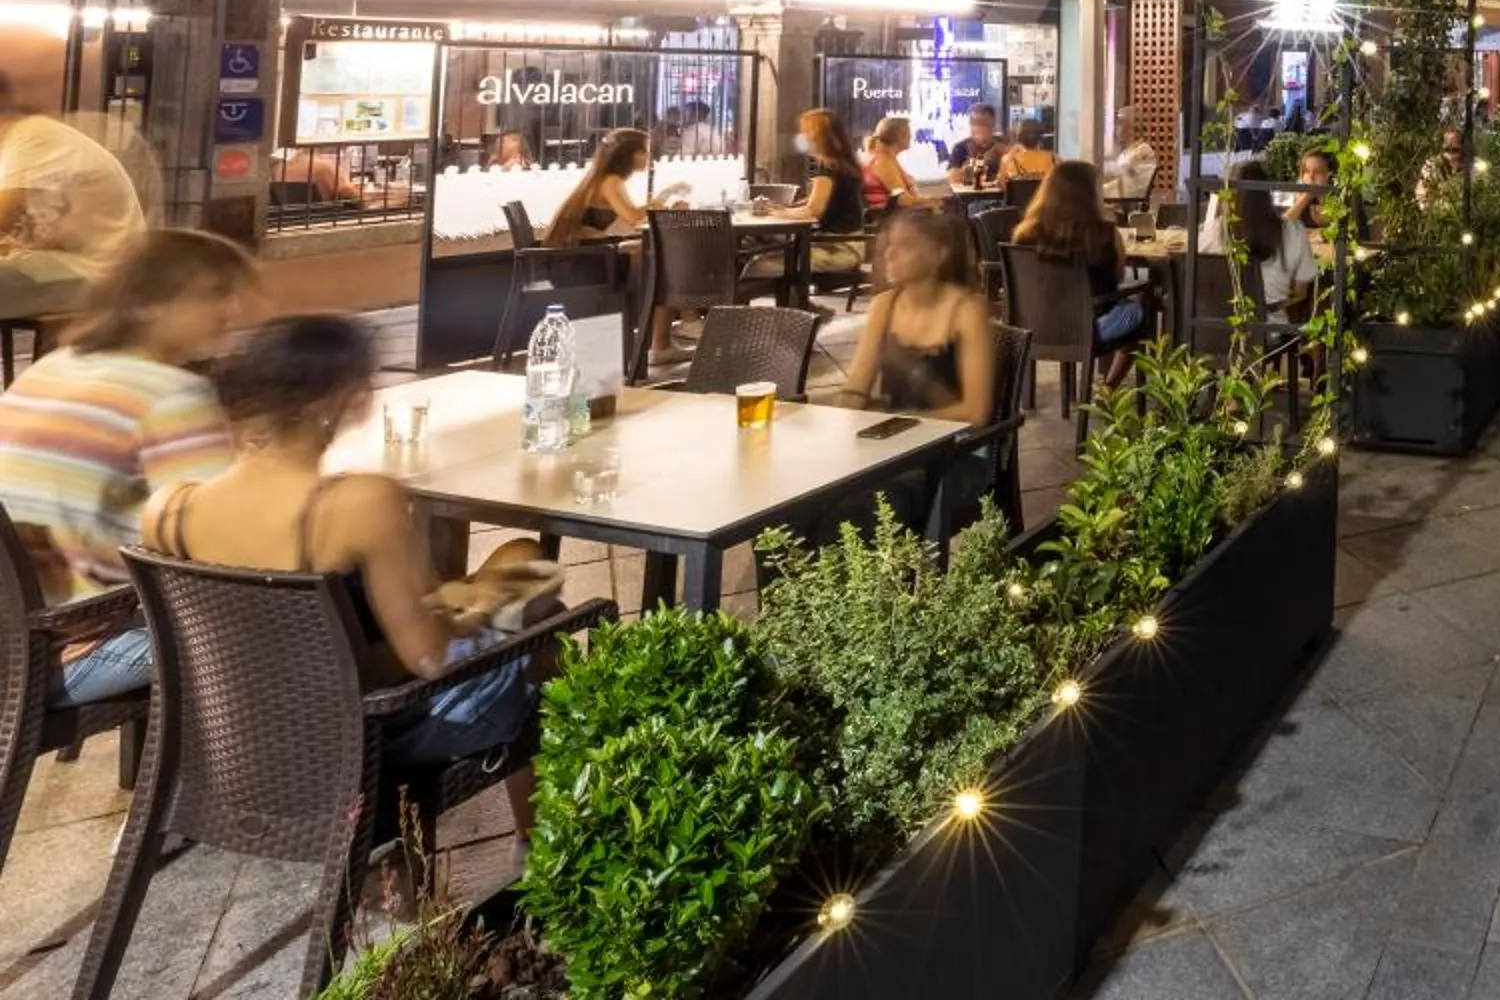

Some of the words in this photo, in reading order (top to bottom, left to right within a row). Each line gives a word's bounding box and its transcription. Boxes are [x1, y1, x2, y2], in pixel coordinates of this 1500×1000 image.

[311, 18, 445, 41] Restaurante
[476, 68, 634, 105] alvalacan
[852, 77, 903, 100] Puerta
